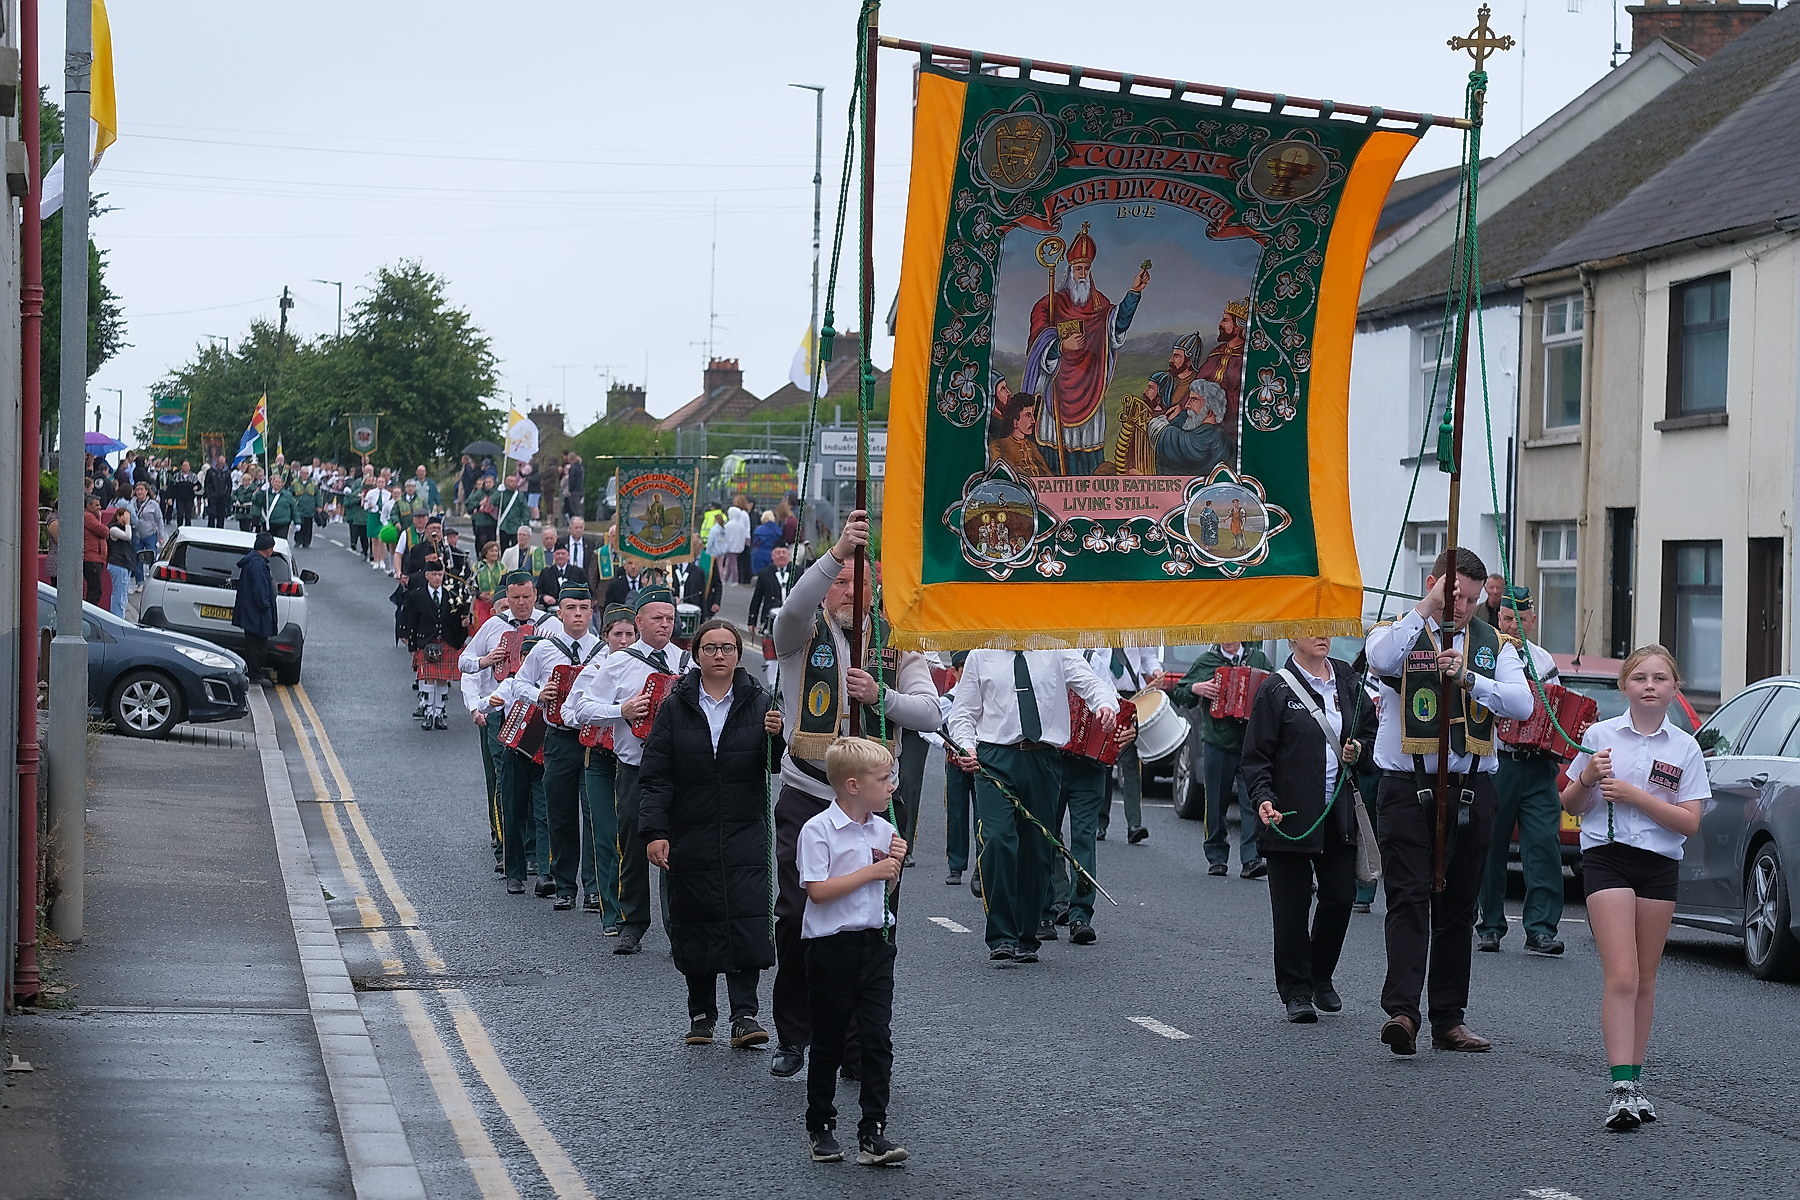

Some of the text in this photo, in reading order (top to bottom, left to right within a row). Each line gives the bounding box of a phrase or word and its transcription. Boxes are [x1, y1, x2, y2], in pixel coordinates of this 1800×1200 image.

[1084, 146, 1218, 172] CORRAN
[1038, 479, 1182, 493] FAITH OF OUR FATHERS
[1062, 497, 1159, 511] LIVING STILL.
